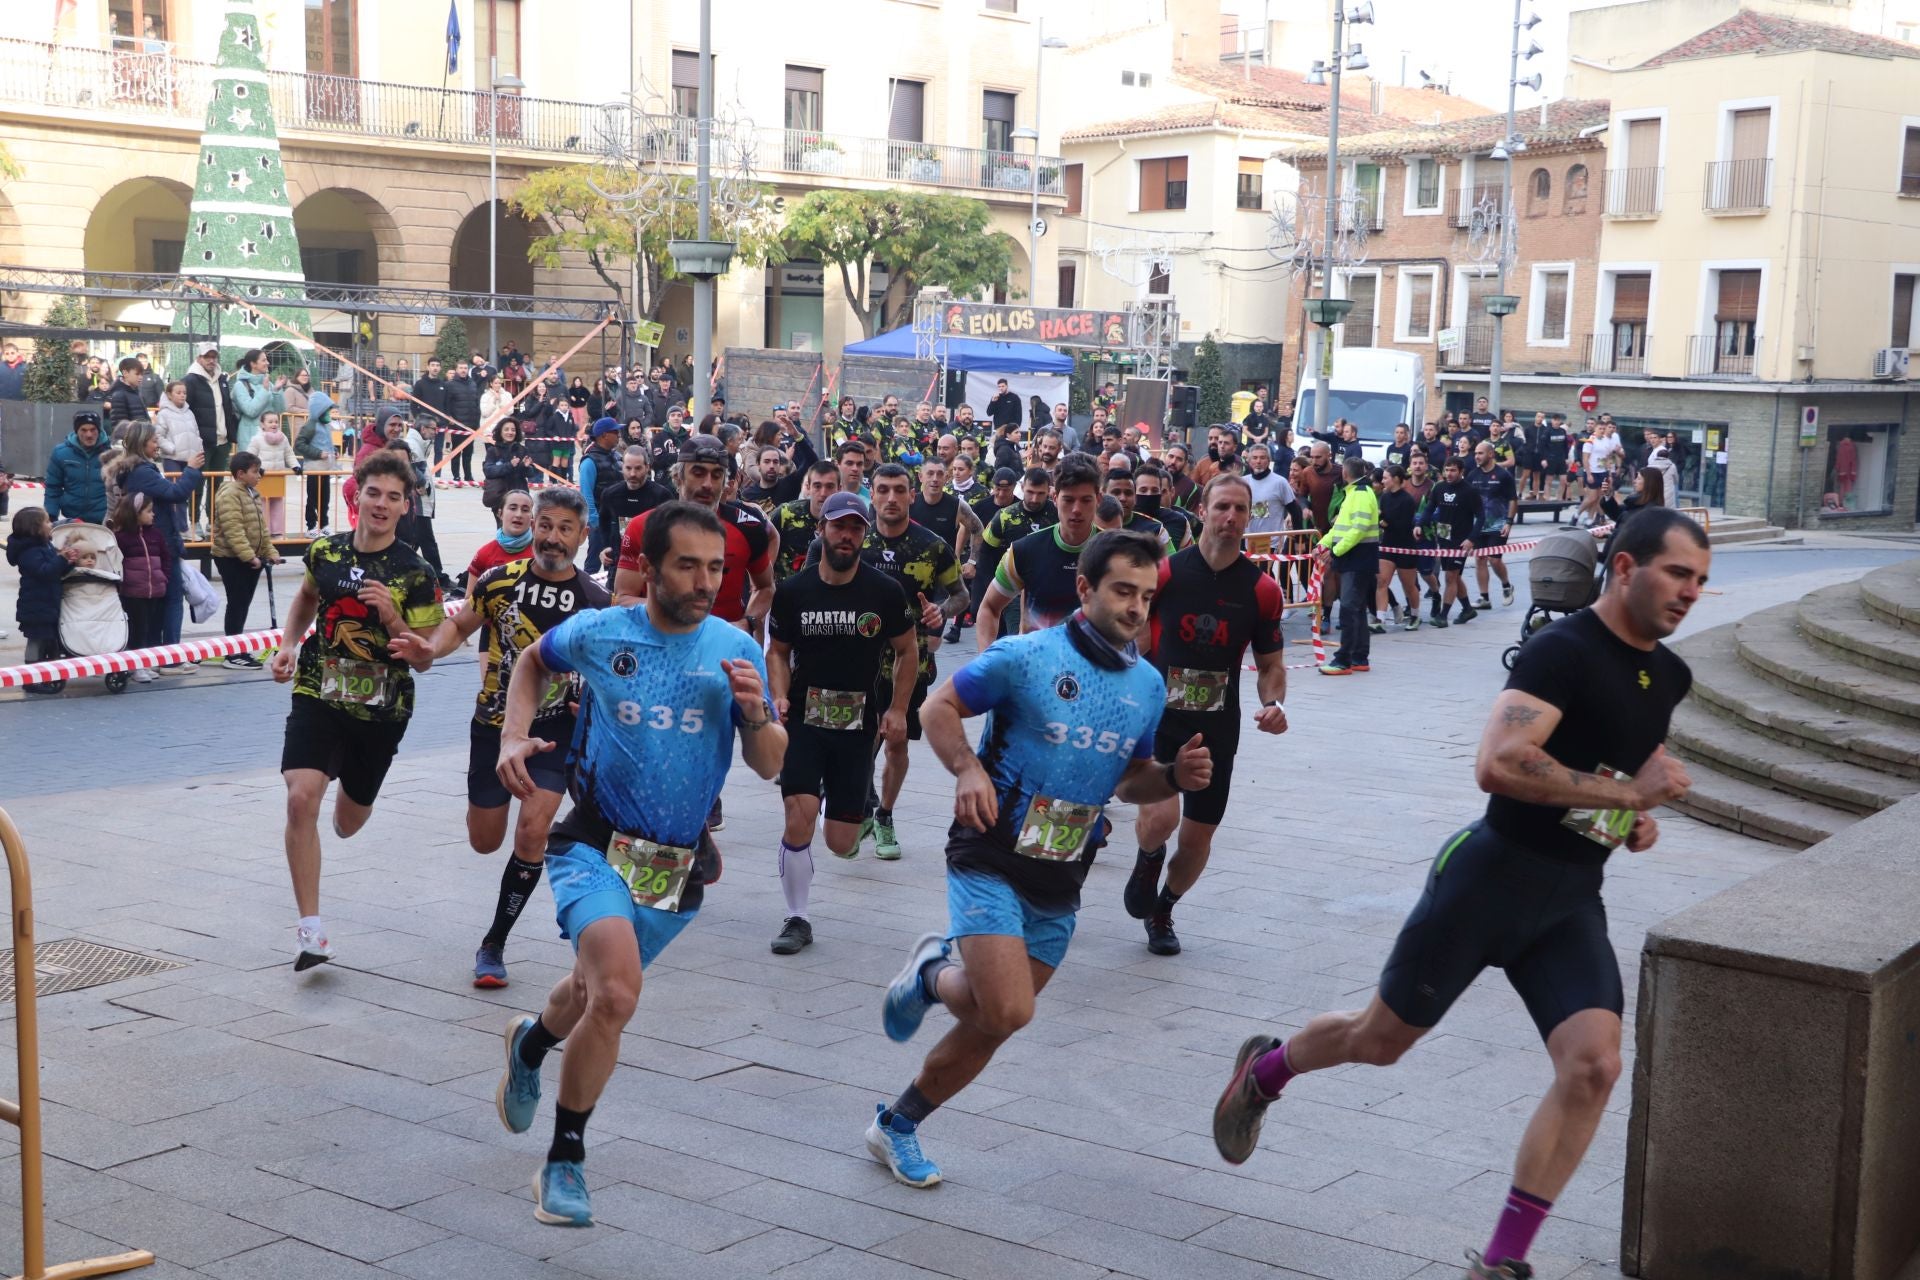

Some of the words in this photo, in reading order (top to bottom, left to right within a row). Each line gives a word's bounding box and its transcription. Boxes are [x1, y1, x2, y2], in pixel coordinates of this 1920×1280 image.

[969, 309, 1036, 335] EOLOS
[1039, 313, 1094, 341] RACE
[514, 581, 575, 612] 1159
[800, 610, 856, 625] SPARTAN
[801, 624, 833, 636] TURIASO
[835, 623, 856, 636] TEAM
[336, 674, 374, 695] 120
[1184, 685, 1209, 703] 88
[617, 700, 705, 734] 835
[819, 703, 852, 721] 125
[1039, 821, 1083, 850] 128
[620, 859, 672, 895] 126
